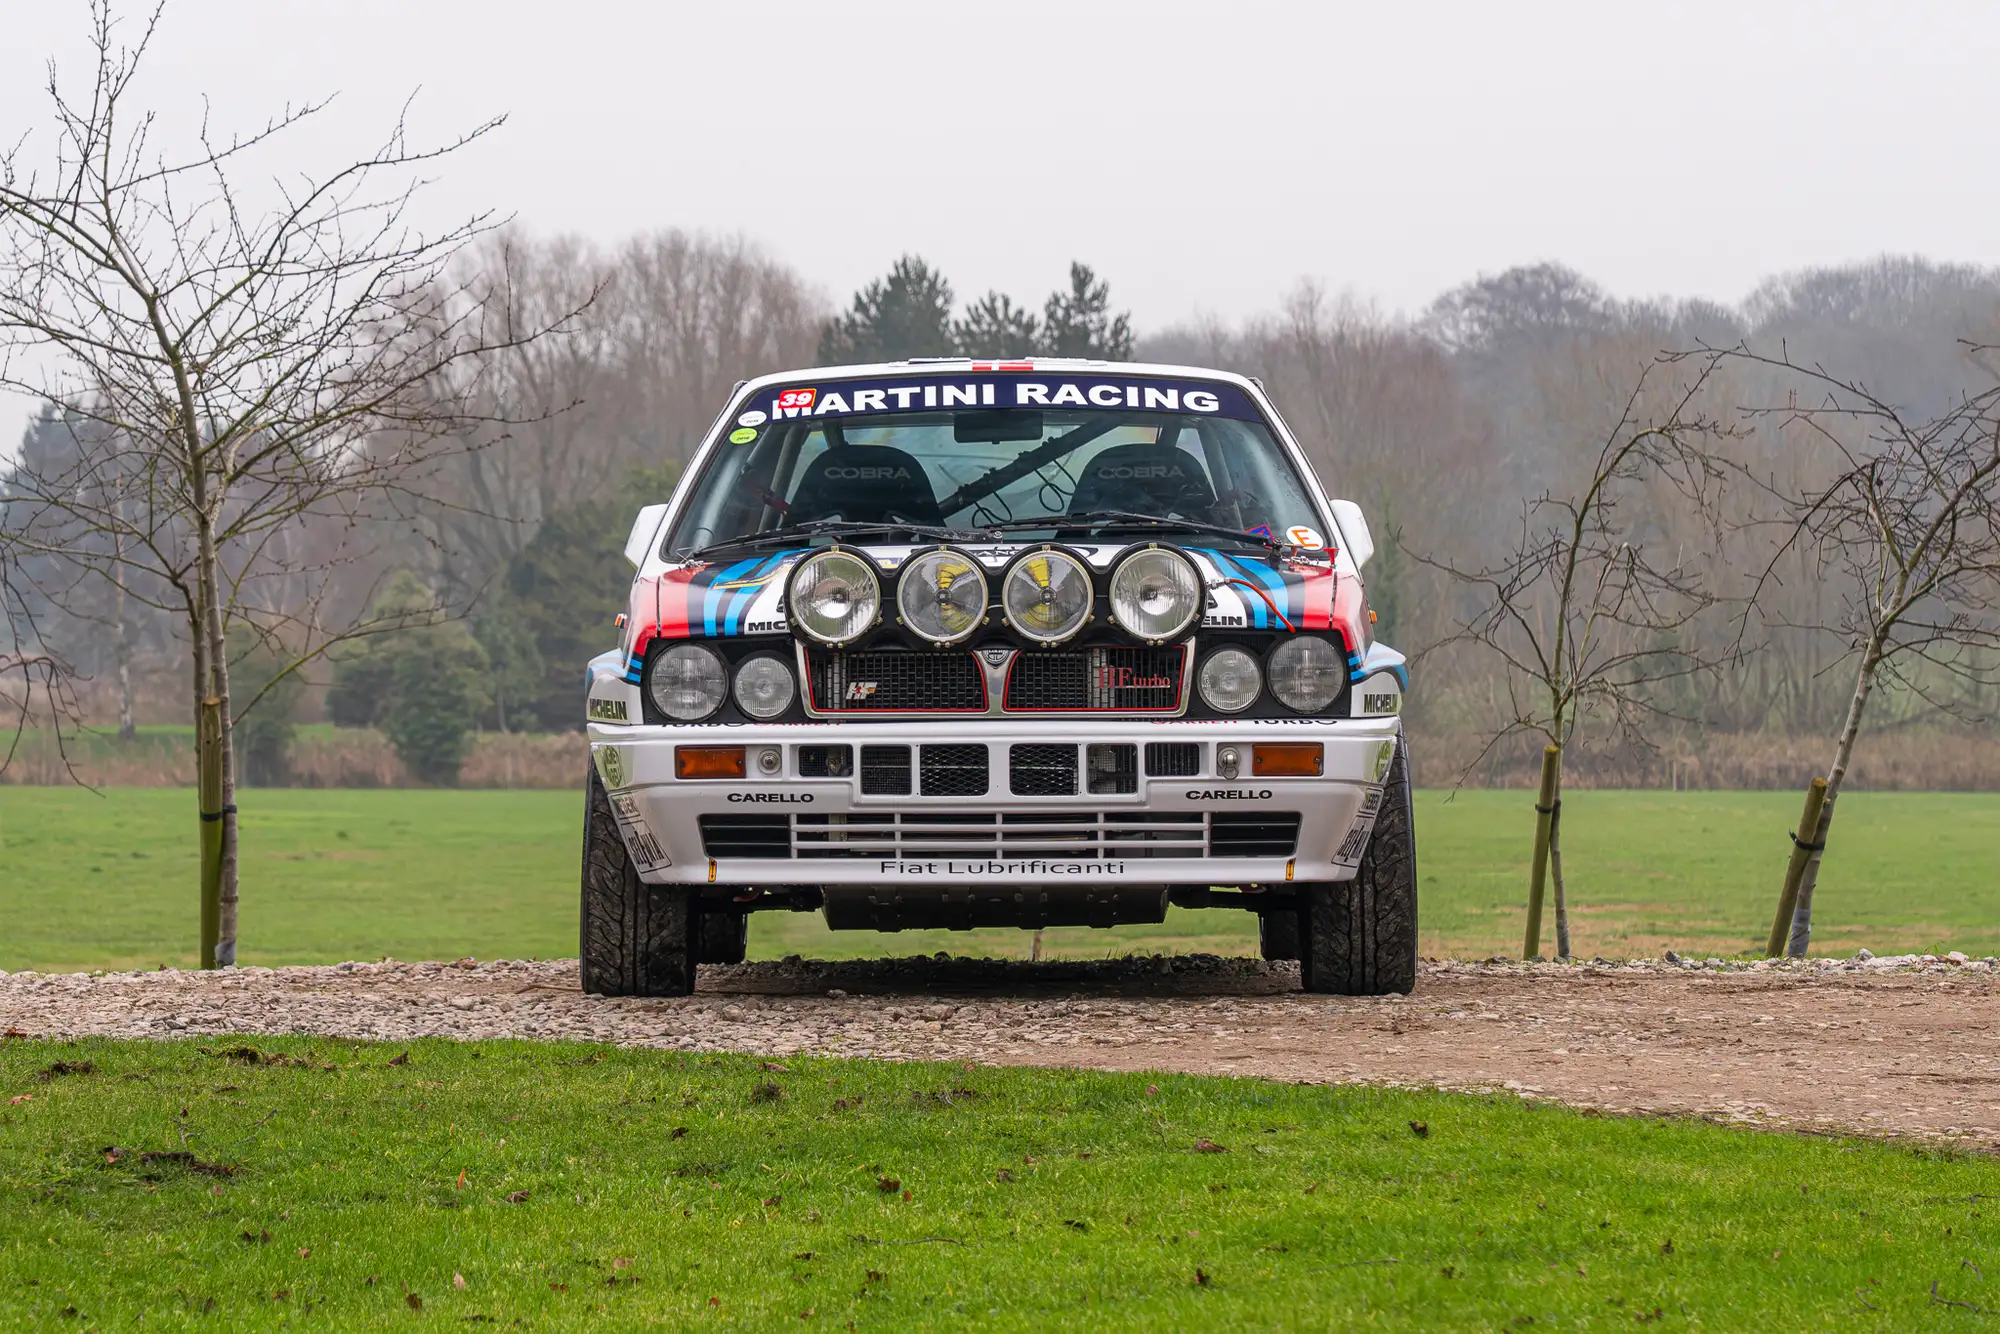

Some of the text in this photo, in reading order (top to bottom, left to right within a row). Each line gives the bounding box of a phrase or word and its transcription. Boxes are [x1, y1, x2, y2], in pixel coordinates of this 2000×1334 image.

[780, 392, 813, 406] 39
[1016, 383, 1220, 412] RACING
[823, 466, 912, 480] COBRA
[1097, 465, 1186, 480] COBRA
[1133, 673, 1171, 687] turbo
[726, 793, 815, 803] CARELLO
[1185, 789, 1273, 800] CARELLO
[880, 861, 1125, 874] Fiat Lubrificanti
